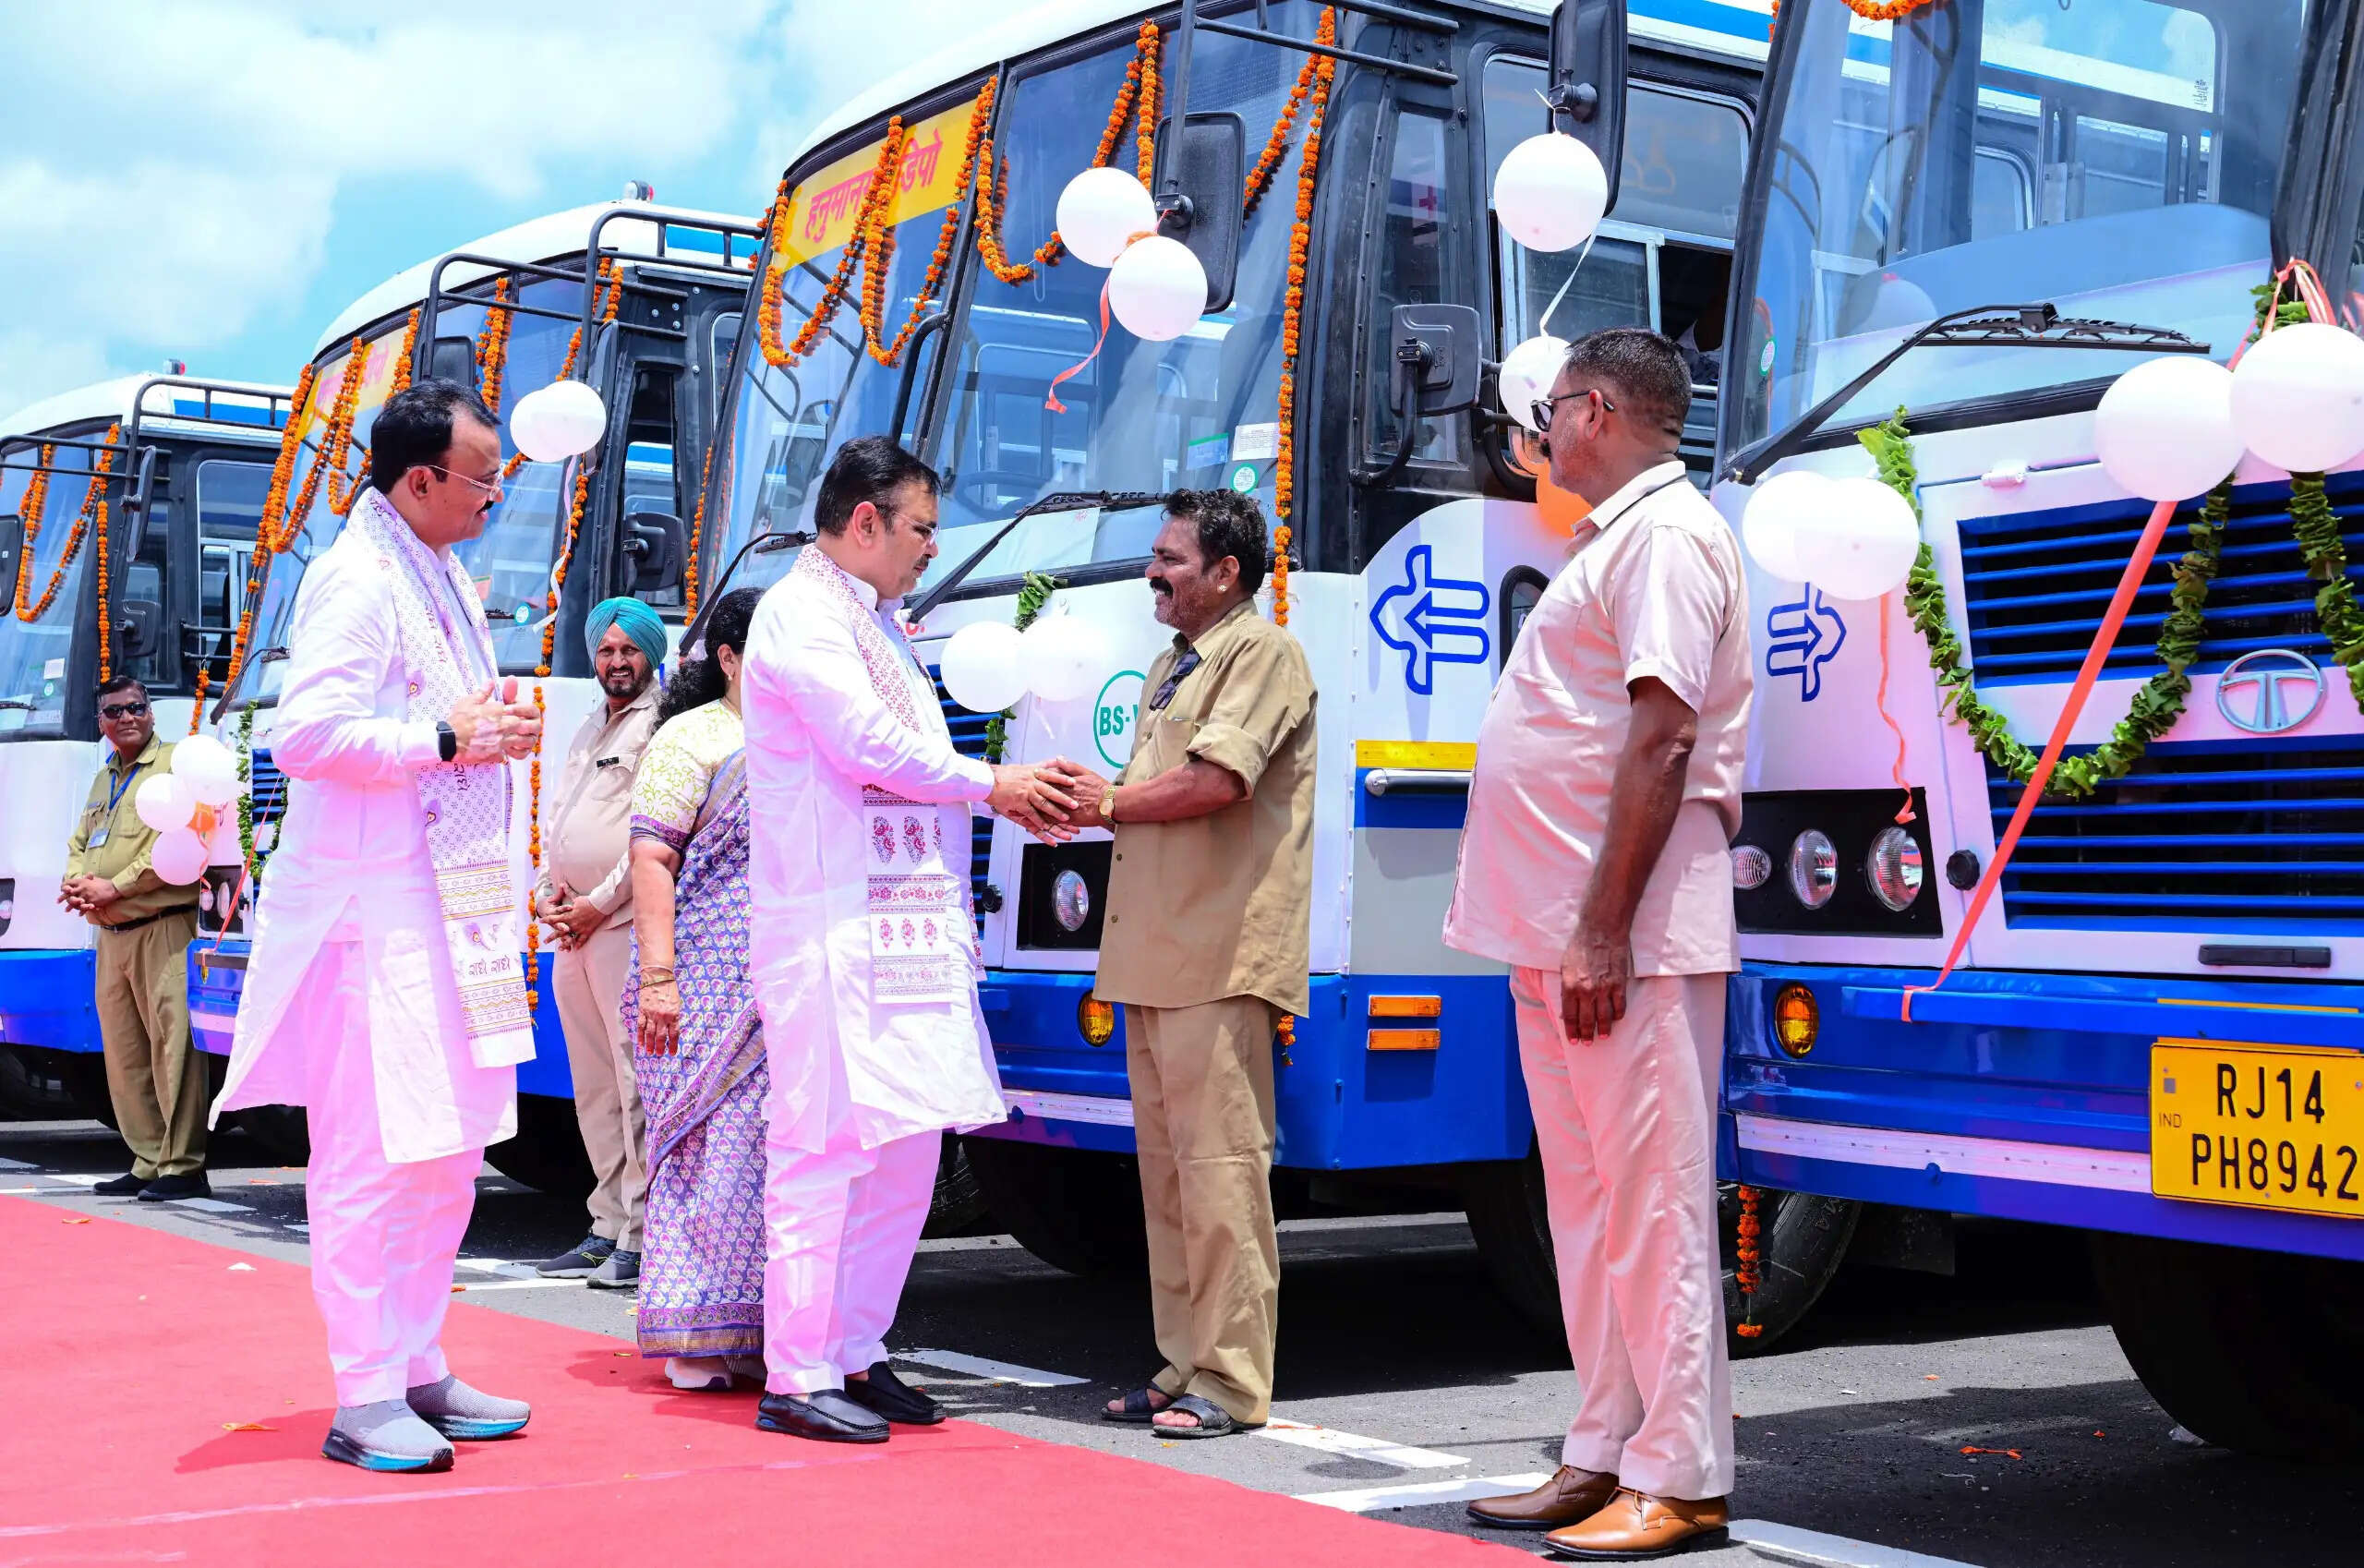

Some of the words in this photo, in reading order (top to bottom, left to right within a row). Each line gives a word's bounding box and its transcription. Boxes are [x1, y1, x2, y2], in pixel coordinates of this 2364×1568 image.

[805, 167, 879, 244] हनुमान
[2158, 1112, 2183, 1128] IND
[2216, 1063, 2325, 1124] RJ14
[2191, 1133, 2359, 1201] PH8942
